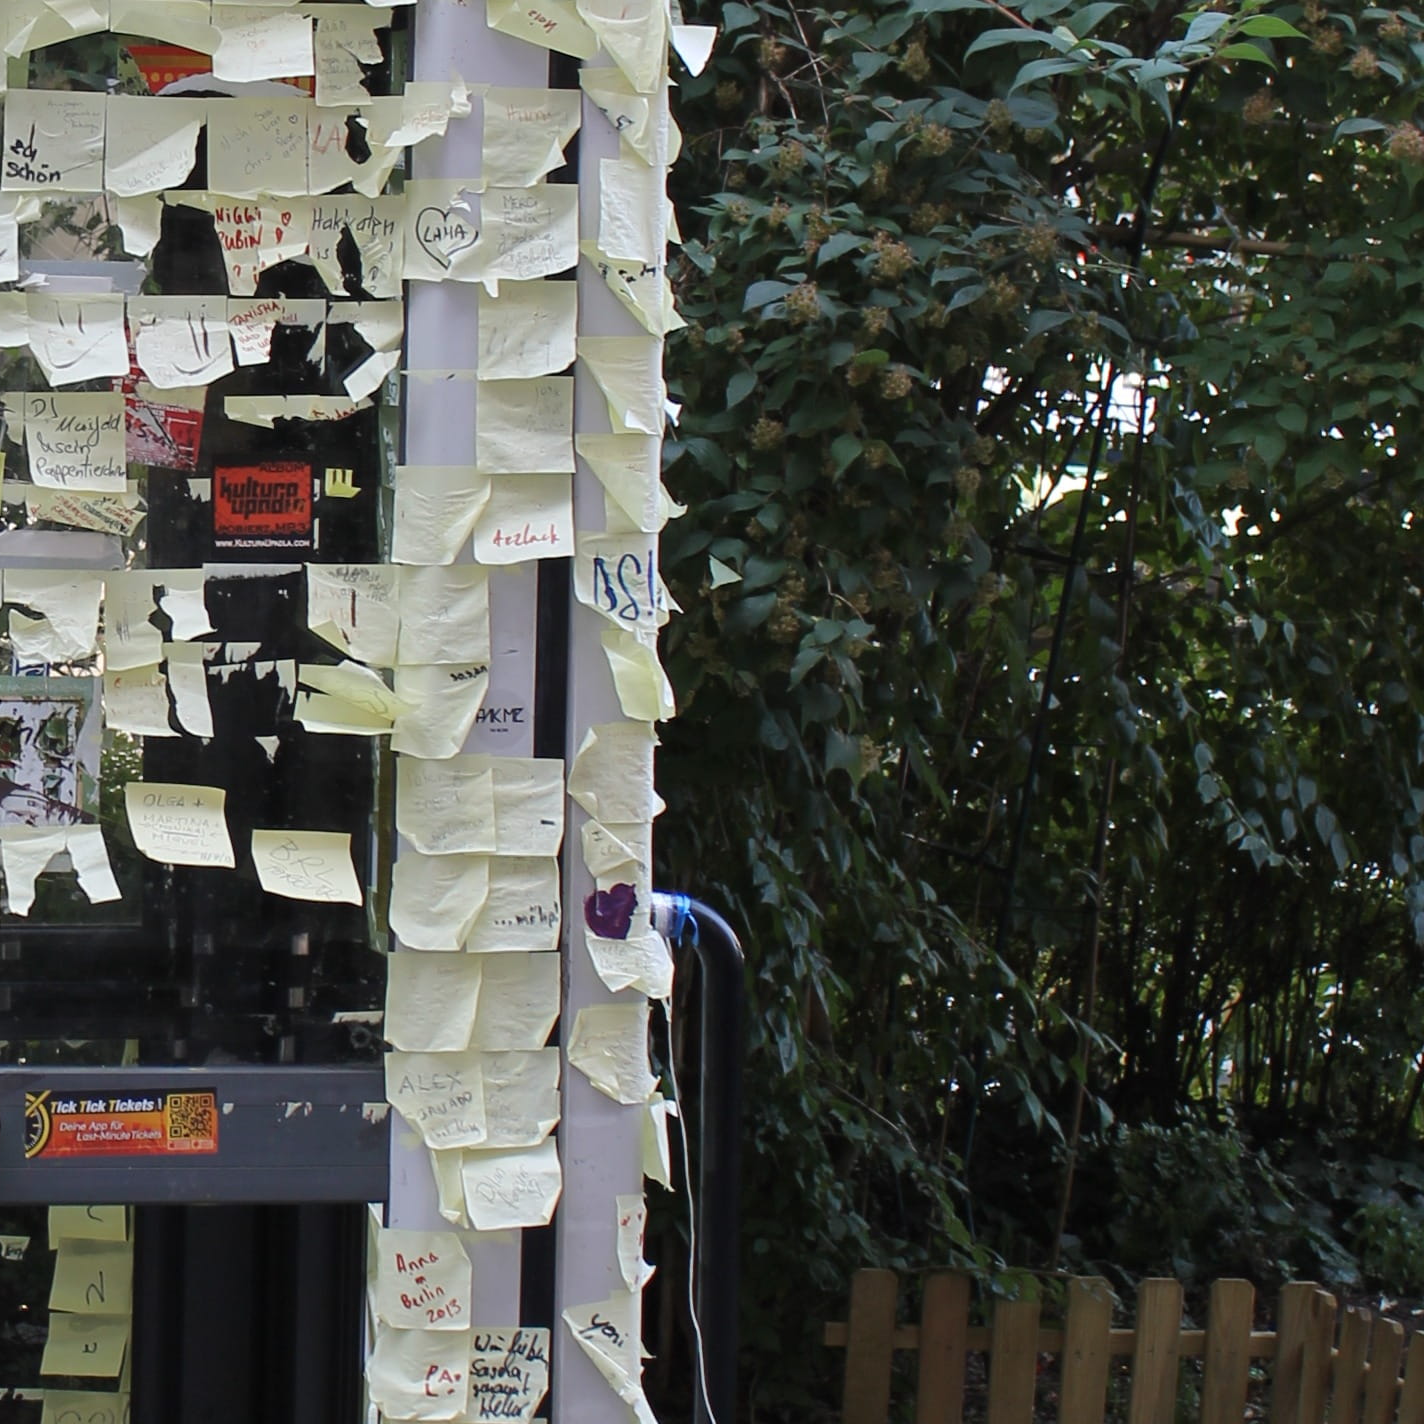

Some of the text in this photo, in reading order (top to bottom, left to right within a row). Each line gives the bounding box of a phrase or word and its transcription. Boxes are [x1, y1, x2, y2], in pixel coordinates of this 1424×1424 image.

[398, 1070, 463, 1095] ALEX
[50, 1098, 154, 1114] Tick Tick Tickets
[59, 1119, 124, 1133] Deine App für
[131, 1130, 163, 1141] Tickets
[394, 1251, 439, 1274] Anna
[399, 1284, 446, 1310] Berlin
[425, 1297, 463, 1325] 2013
